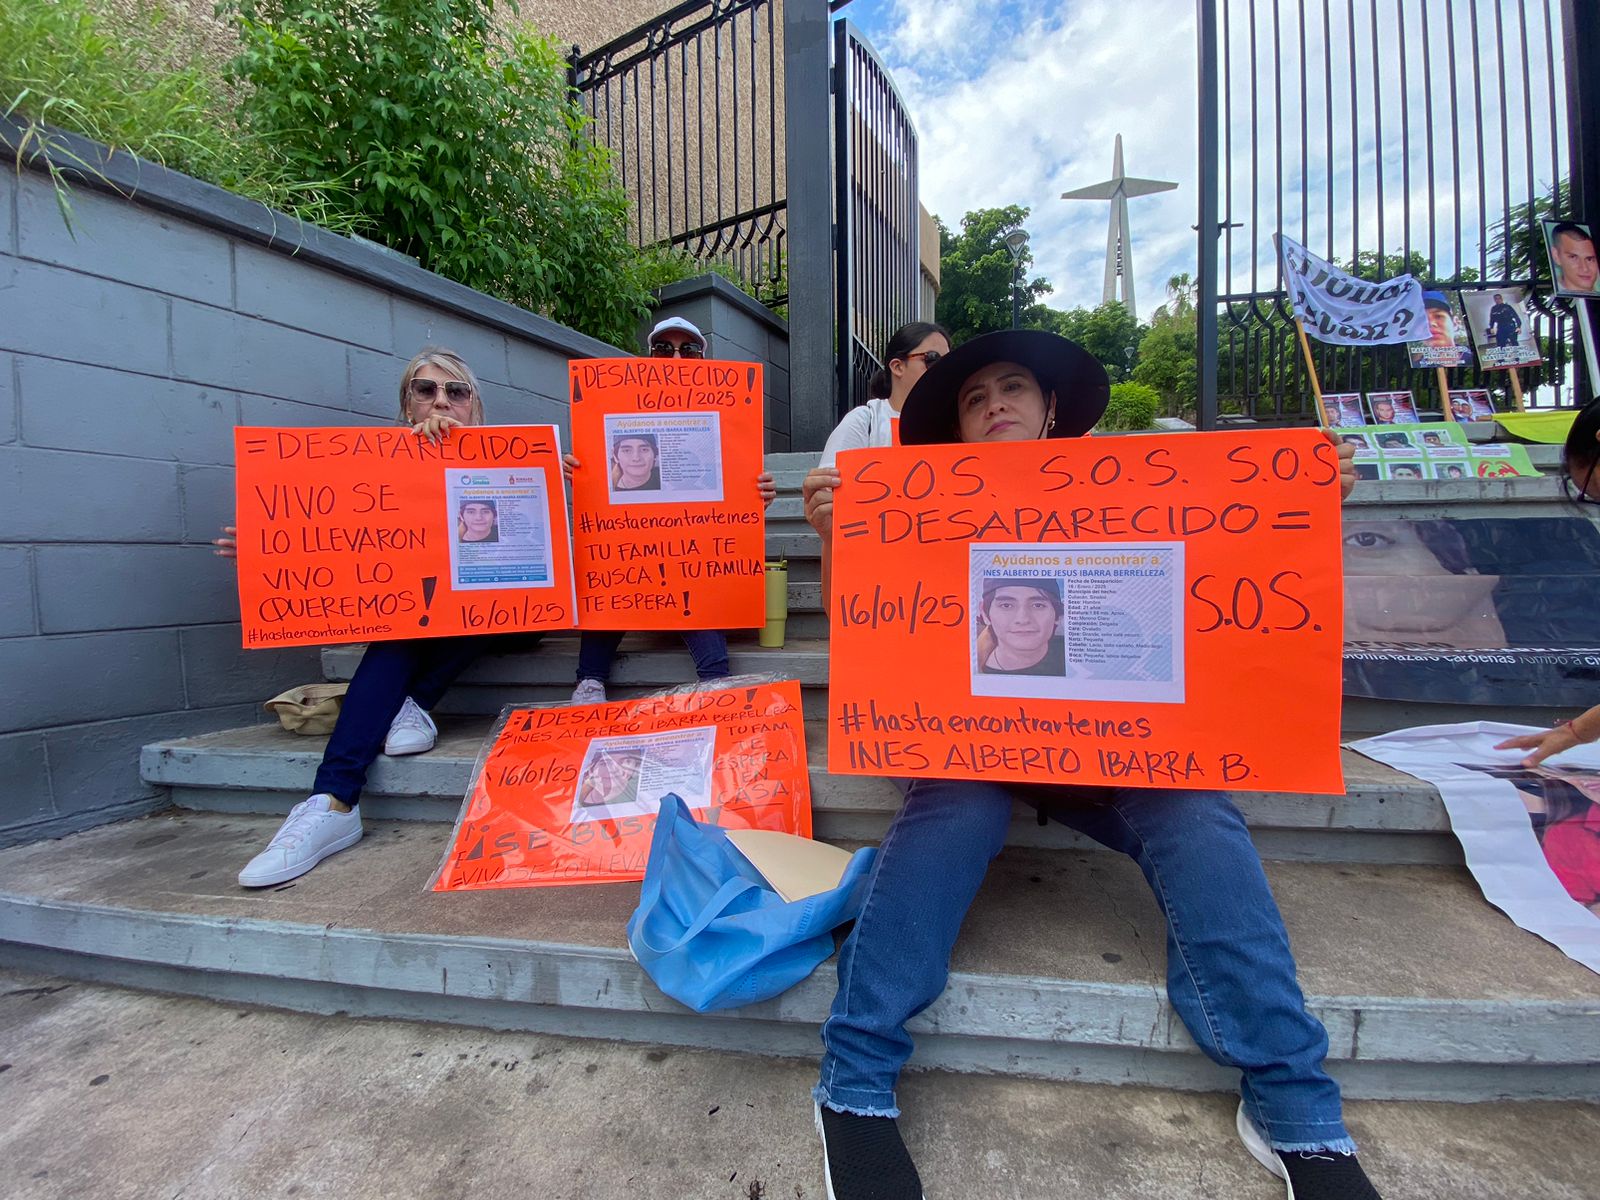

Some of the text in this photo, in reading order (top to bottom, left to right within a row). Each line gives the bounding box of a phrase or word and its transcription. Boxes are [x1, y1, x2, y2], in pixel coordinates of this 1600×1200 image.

[636, 388, 736, 410] 16/01/2025
[255, 483, 399, 520] VIVO SE
[580, 508, 760, 533] #hastaencontrarteines
[262, 526, 426, 554] LO LLEVARON
[585, 537, 736, 561] TU FAMILIA TE
[678, 561, 701, 578] TU
[706, 559, 764, 578] FAMILIA
[983, 568, 1165, 577] INES ALBERTO DE JESUS IBARRA BERRELLEZA
[992, 554, 1060, 568] Ayúdanos
[1064, 556, 1073, 565] a
[1076, 554, 1146, 566] encontrar
[262, 562, 393, 590] VIVO LO
[462, 595, 565, 629] 16/01/25
[581, 595, 605, 612] TE
[841, 571, 1322, 634] 16/01/25 S.O.S.
[248, 623, 392, 643] #hastaencontrarteines
[513, 731, 552, 744] INES
[558, 722, 640, 740] ALBERTO
[651, 713, 708, 729] IBARRA
[837, 699, 1153, 738] #hastaencontrarteines
[726, 726, 748, 736] TU
[499, 758, 578, 787] 16/01/25
[715, 750, 789, 771] ESPERA
[849, 741, 1259, 784] INES ALBERTO IBARRA B.
[741, 768, 768, 784] EN
[718, 781, 789, 804] CASA
[585, 851, 647, 877] LLEVA
